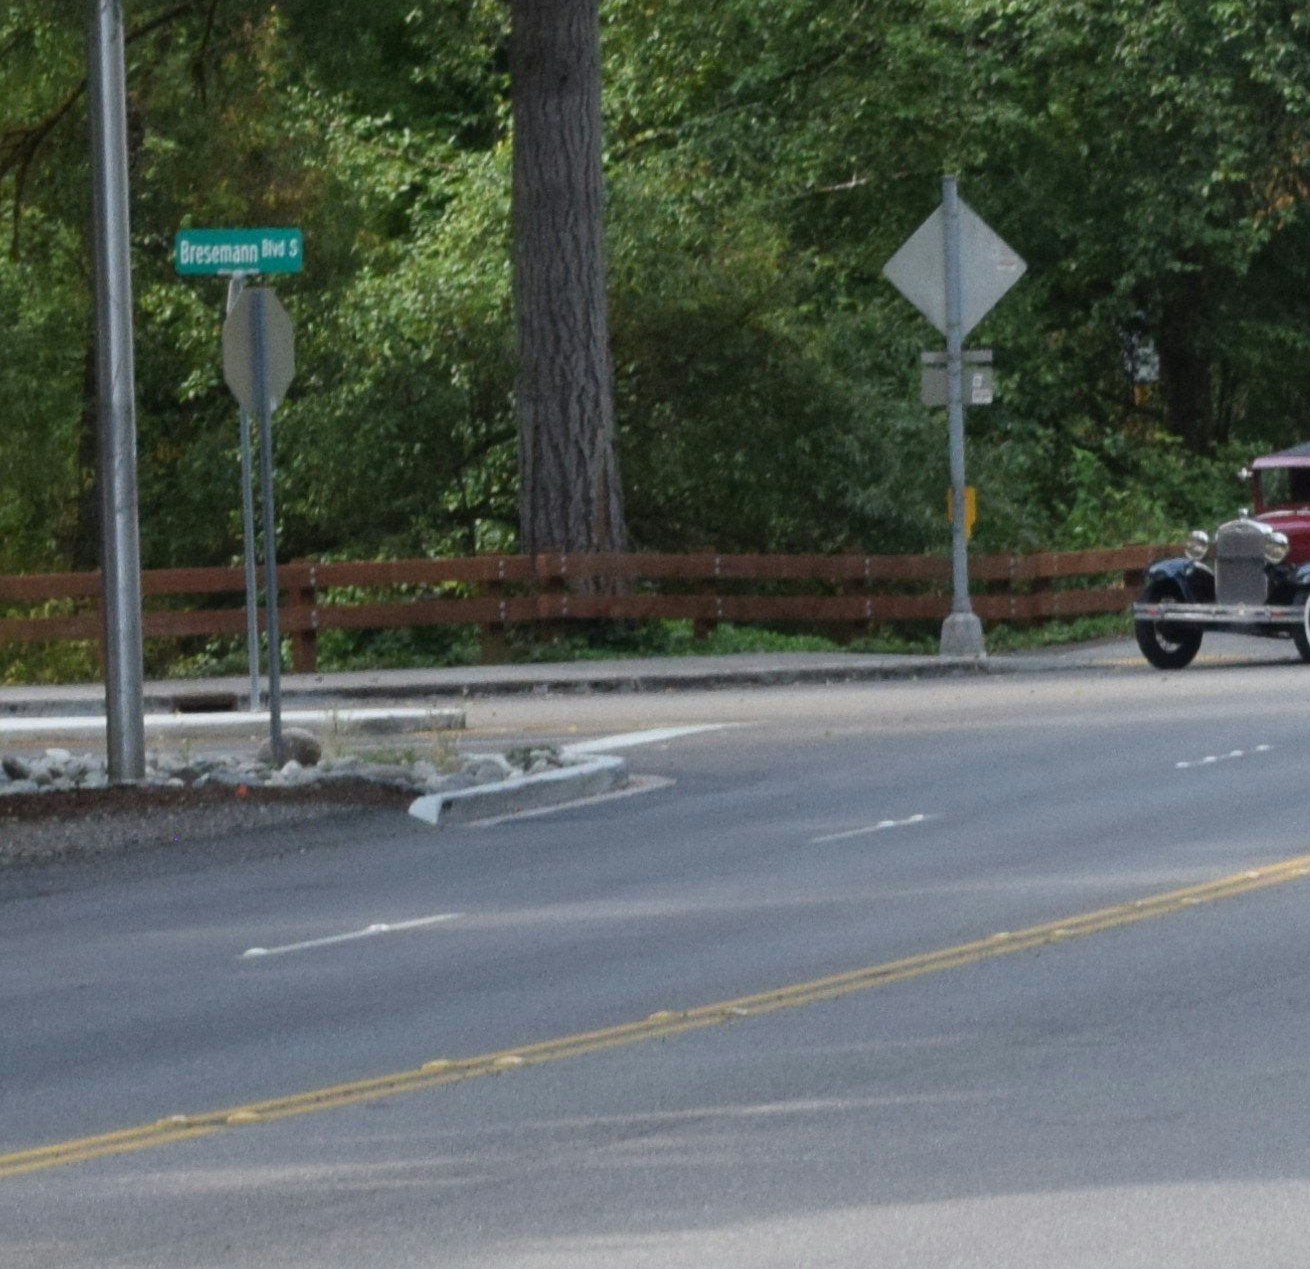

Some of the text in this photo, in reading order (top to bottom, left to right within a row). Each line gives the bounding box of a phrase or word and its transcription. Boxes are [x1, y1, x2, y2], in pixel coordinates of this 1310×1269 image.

[180, 238, 298, 264] Bresemann Blvd S
